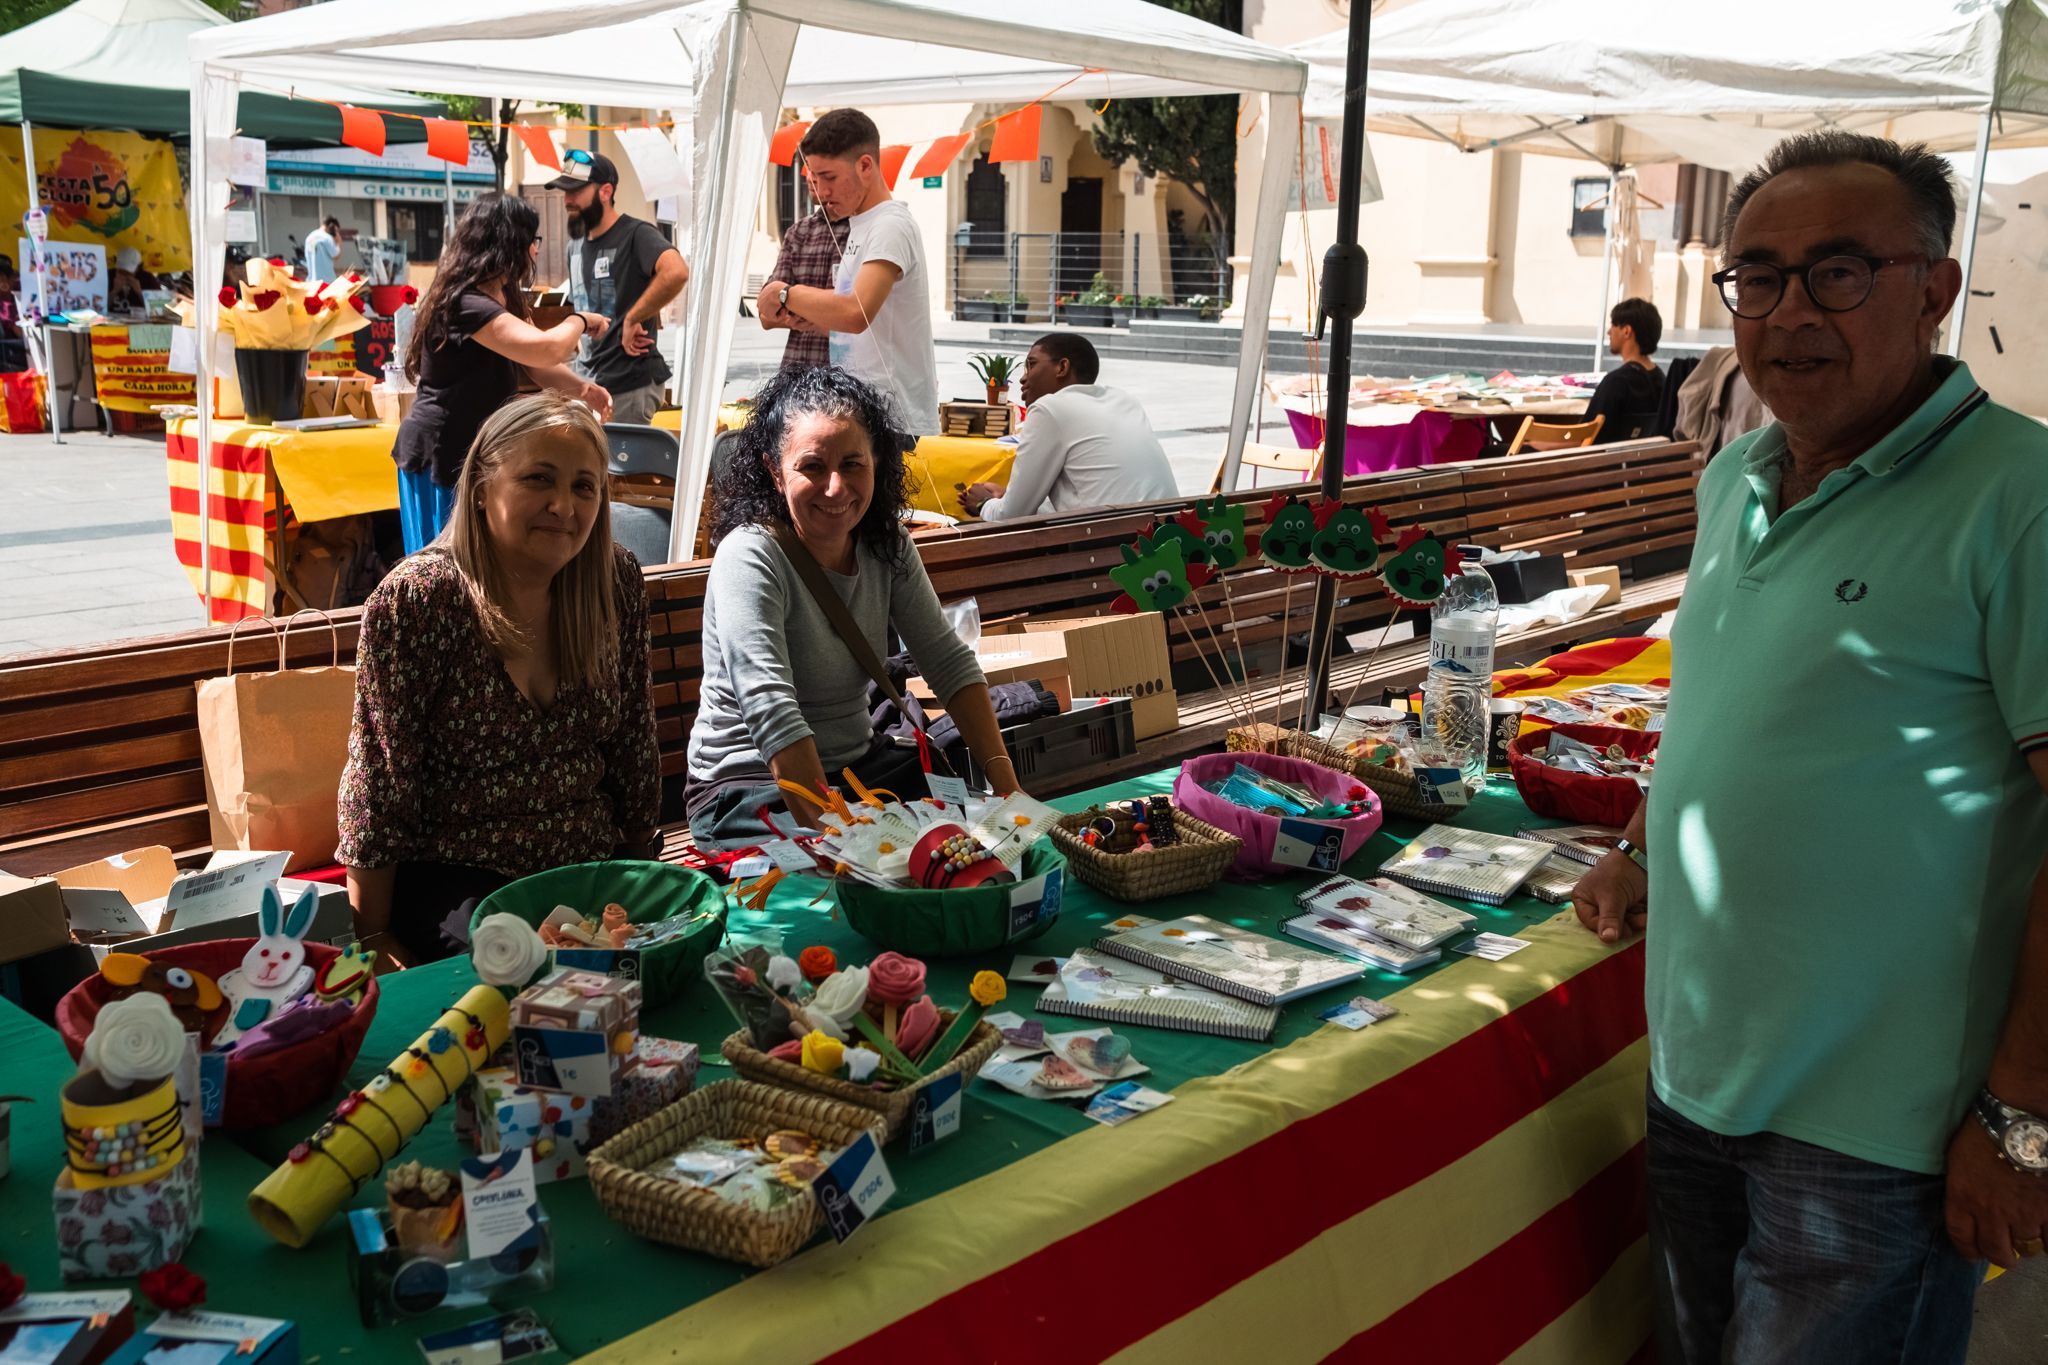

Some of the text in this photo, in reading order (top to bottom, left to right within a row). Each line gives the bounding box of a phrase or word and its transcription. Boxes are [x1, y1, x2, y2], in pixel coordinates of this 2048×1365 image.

[92, 174, 131, 209] 50
[364, 184, 445, 198] CENTRE
[124, 382, 155, 391] CADA
[157, 383, 187, 392] HORA
[561, 1067, 578, 1079] 1€
